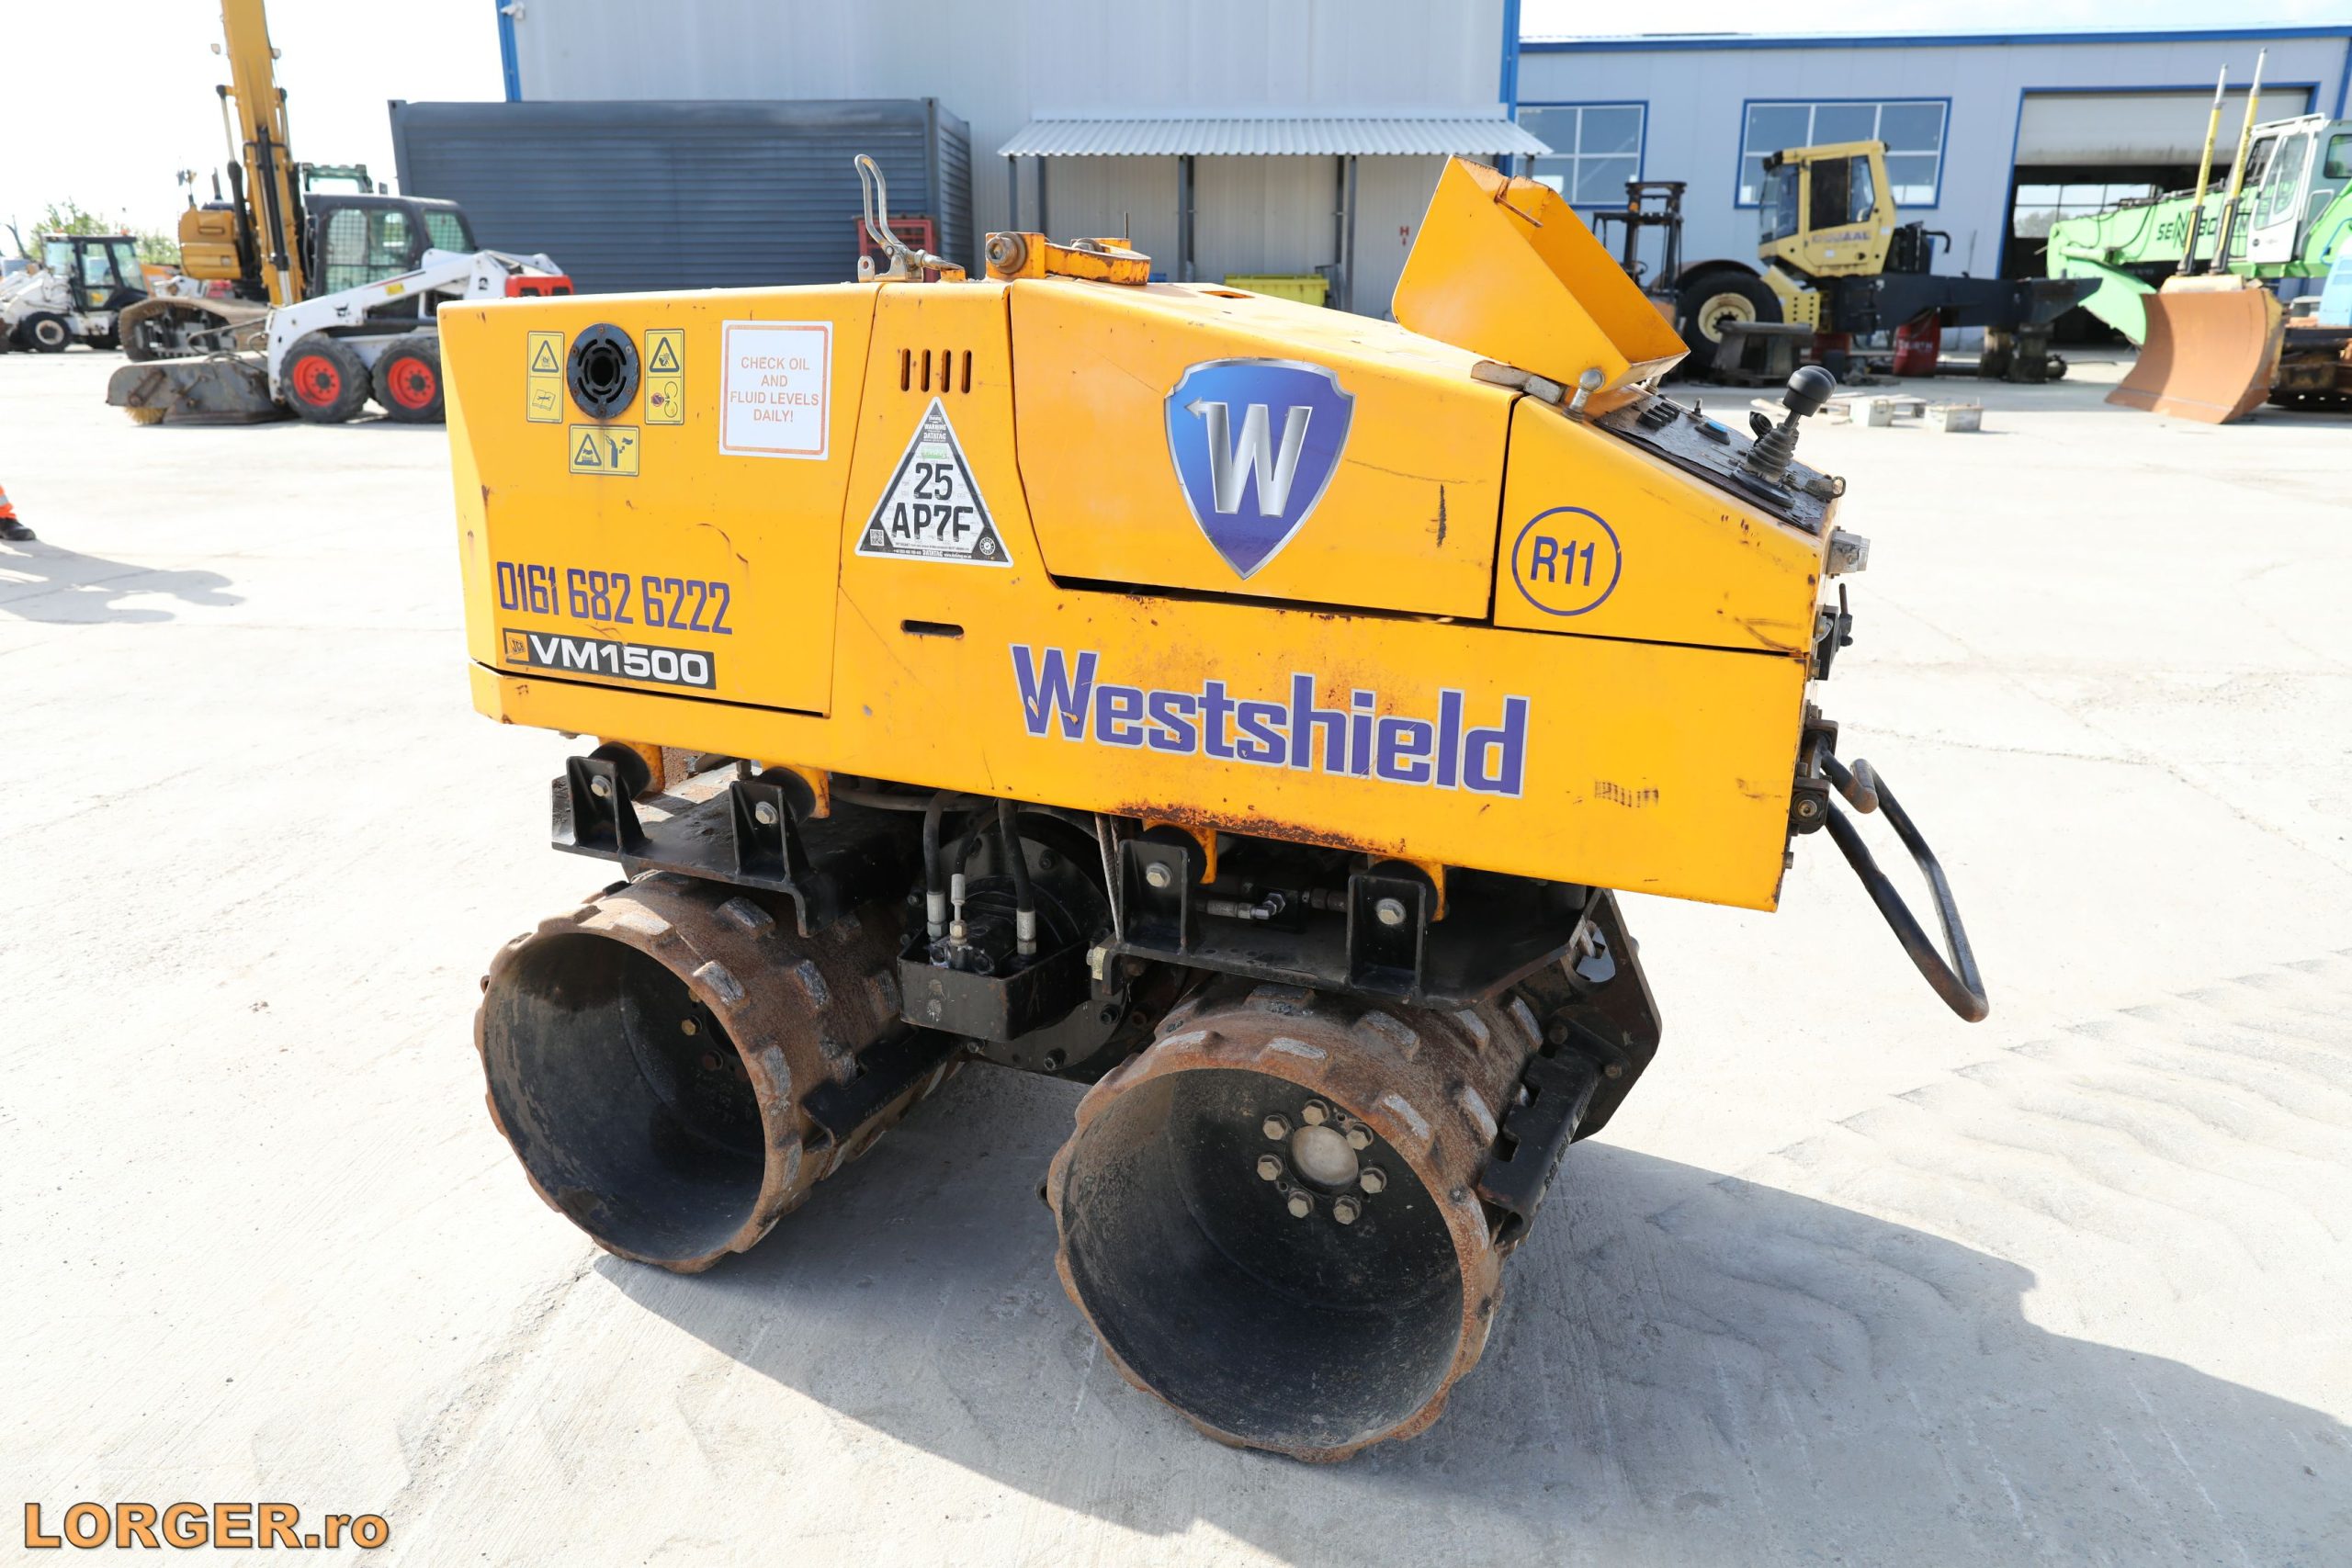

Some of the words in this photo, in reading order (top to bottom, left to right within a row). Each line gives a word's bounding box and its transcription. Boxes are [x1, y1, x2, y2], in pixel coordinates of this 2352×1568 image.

[741, 356, 786, 369] CHECK
[788, 357, 810, 370] OIL
[761, 375, 788, 387] AND
[730, 391, 766, 403] FLUID
[770, 392, 820, 406] LEVELS
[753, 409, 794, 423] DAILY!
[923, 432, 946, 440] DATATAG
[1185, 399, 1313, 518] W
[914, 462, 954, 501] 25
[891, 502, 974, 543] AP7F
[1530, 536, 1596, 587] R11
[496, 561, 560, 615] 0161
[567, 568, 634, 625] 682
[641, 575, 733, 635] 6222
[529, 634, 709, 685] VM1500
[1011, 643, 1532, 798] Westshield
